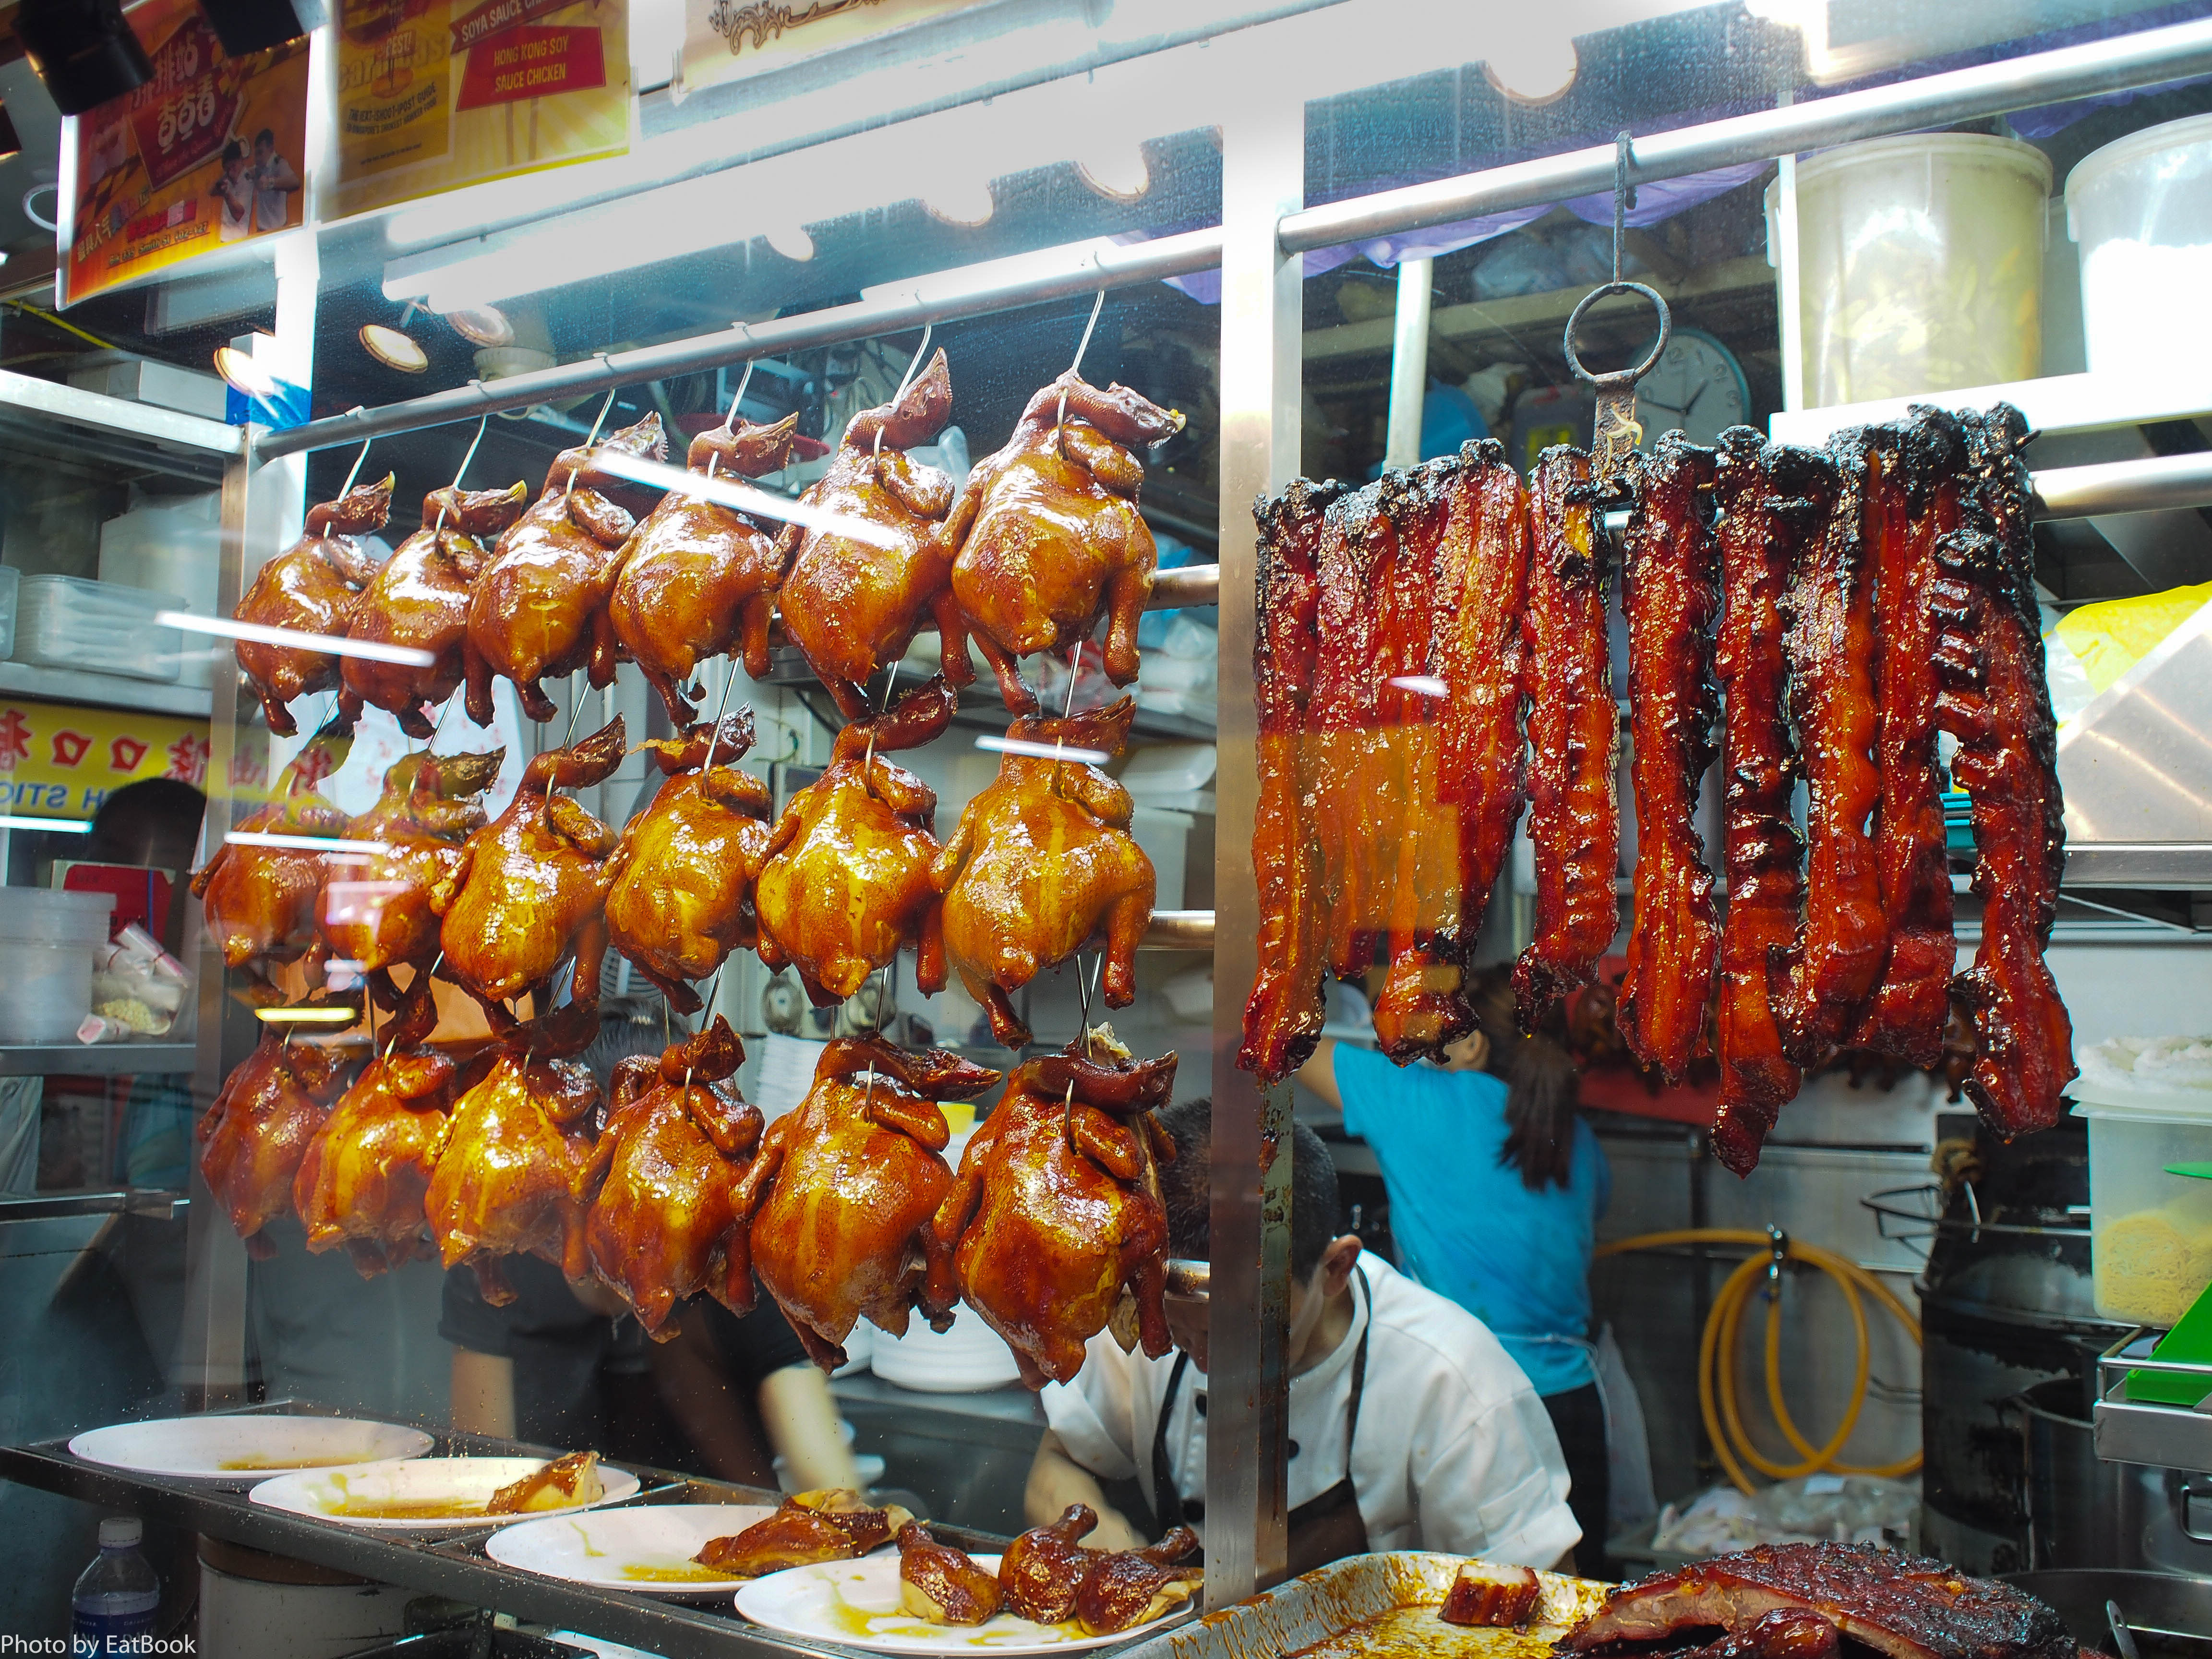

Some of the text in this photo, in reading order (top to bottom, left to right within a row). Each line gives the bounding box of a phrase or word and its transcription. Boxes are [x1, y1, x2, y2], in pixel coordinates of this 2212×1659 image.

[461, 0, 523, 43] SOYA SAUCE
[494, 35, 569, 68] HONG KONG SOY
[417, 82, 437, 103] GUIDE
[495, 62, 566, 93] SAUCE CHICKEN
